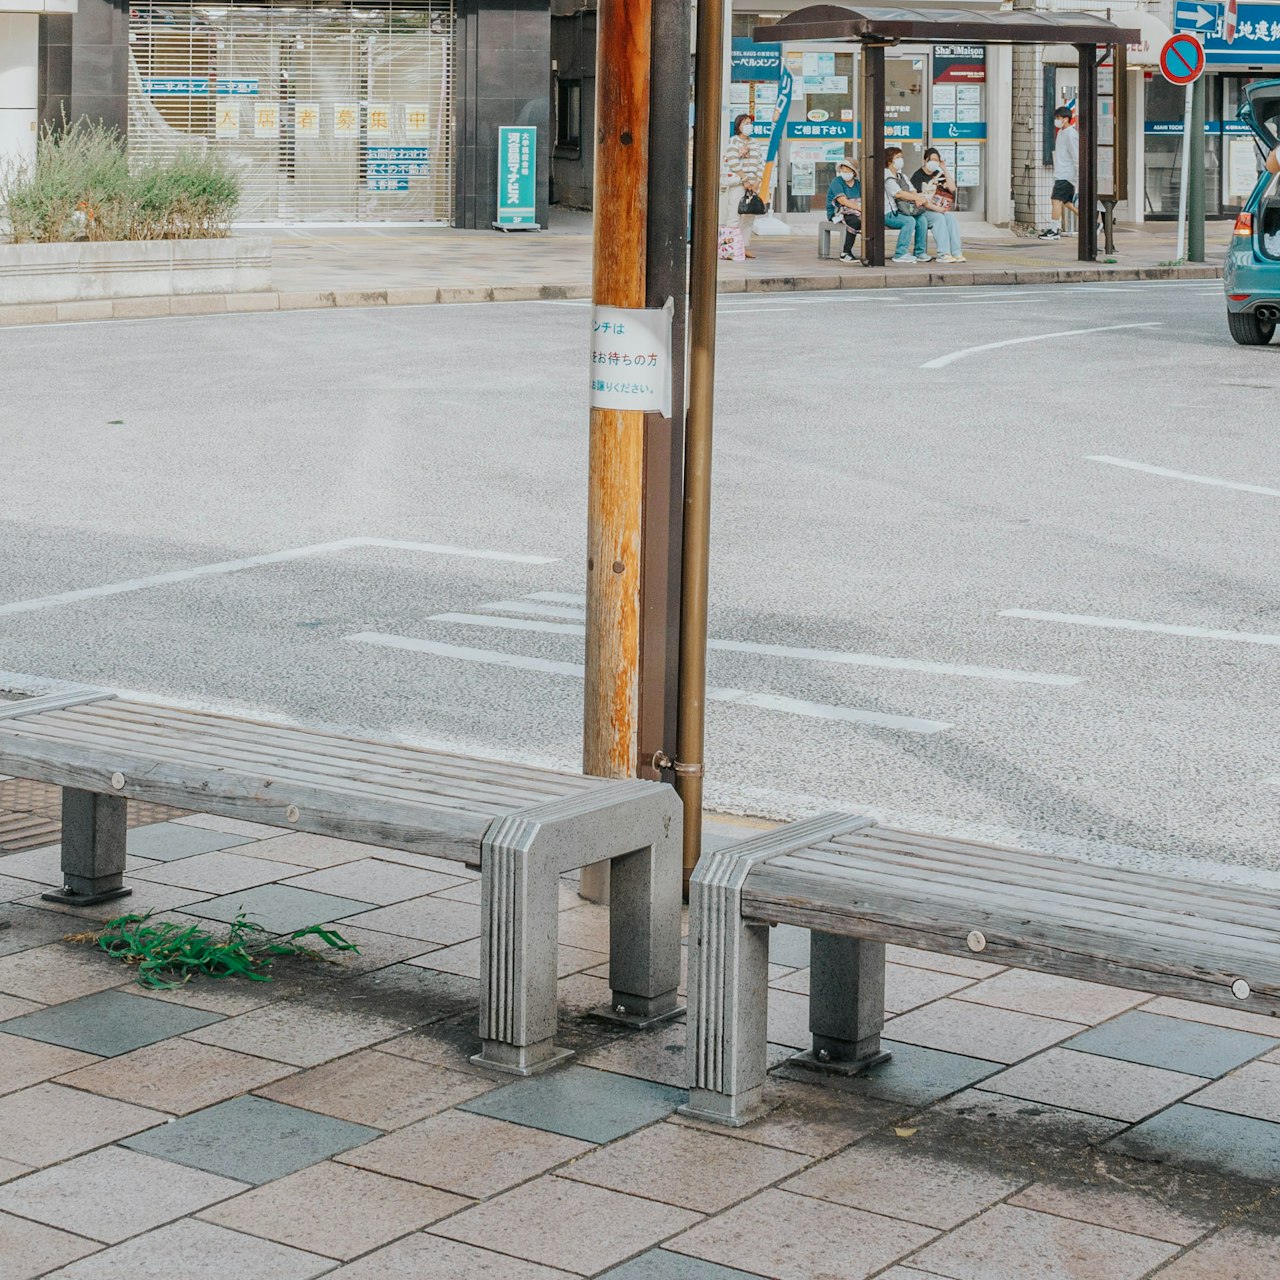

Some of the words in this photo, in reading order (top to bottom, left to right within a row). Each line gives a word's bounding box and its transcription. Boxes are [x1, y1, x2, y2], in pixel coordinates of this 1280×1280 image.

[794, 124, 847, 136] ご相談下さい
